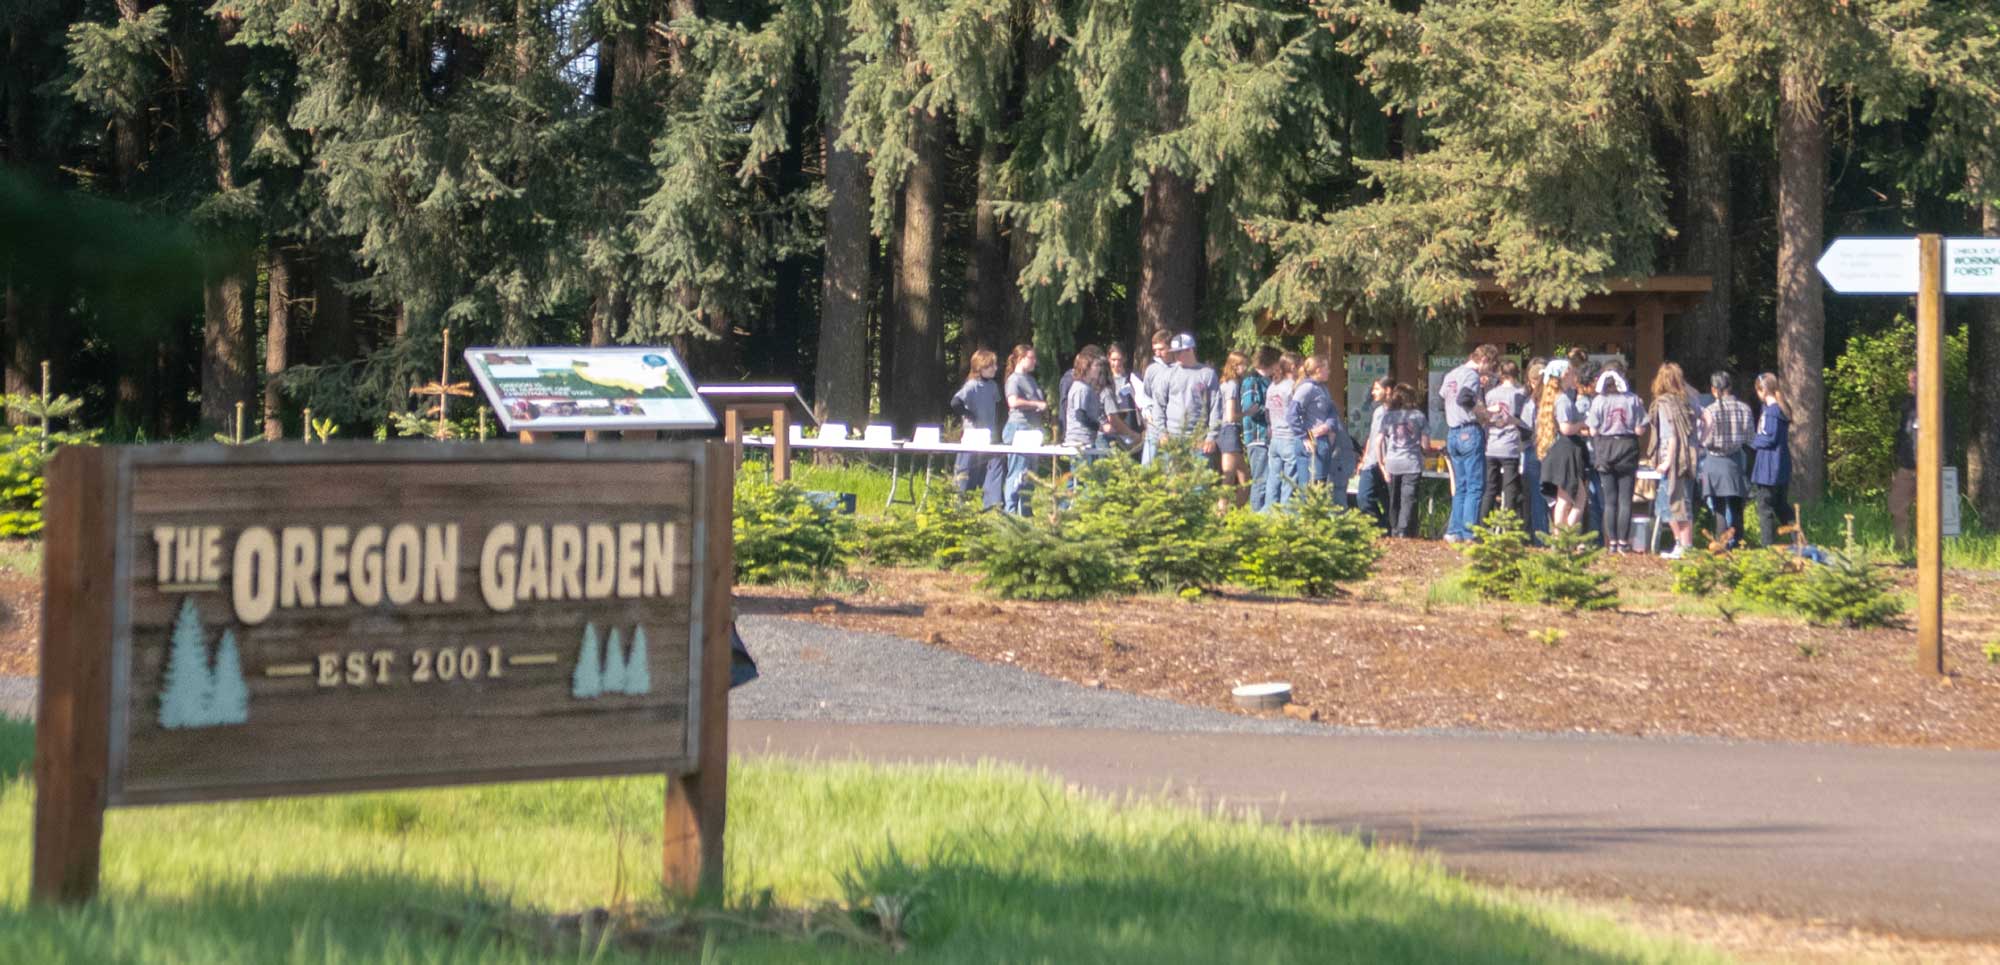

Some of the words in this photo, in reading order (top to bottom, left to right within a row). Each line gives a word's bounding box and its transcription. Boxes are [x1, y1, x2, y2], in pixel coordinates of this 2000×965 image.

[1953, 266, 1994, 276] FOREST
[1432, 357, 1467, 368] WELCO
[153, 526, 223, 583] THE
[232, 523, 460, 625] OREGON
[480, 522, 676, 612] GARDEN
[318, 652, 395, 686] EST
[412, 646, 502, 682] 2001
